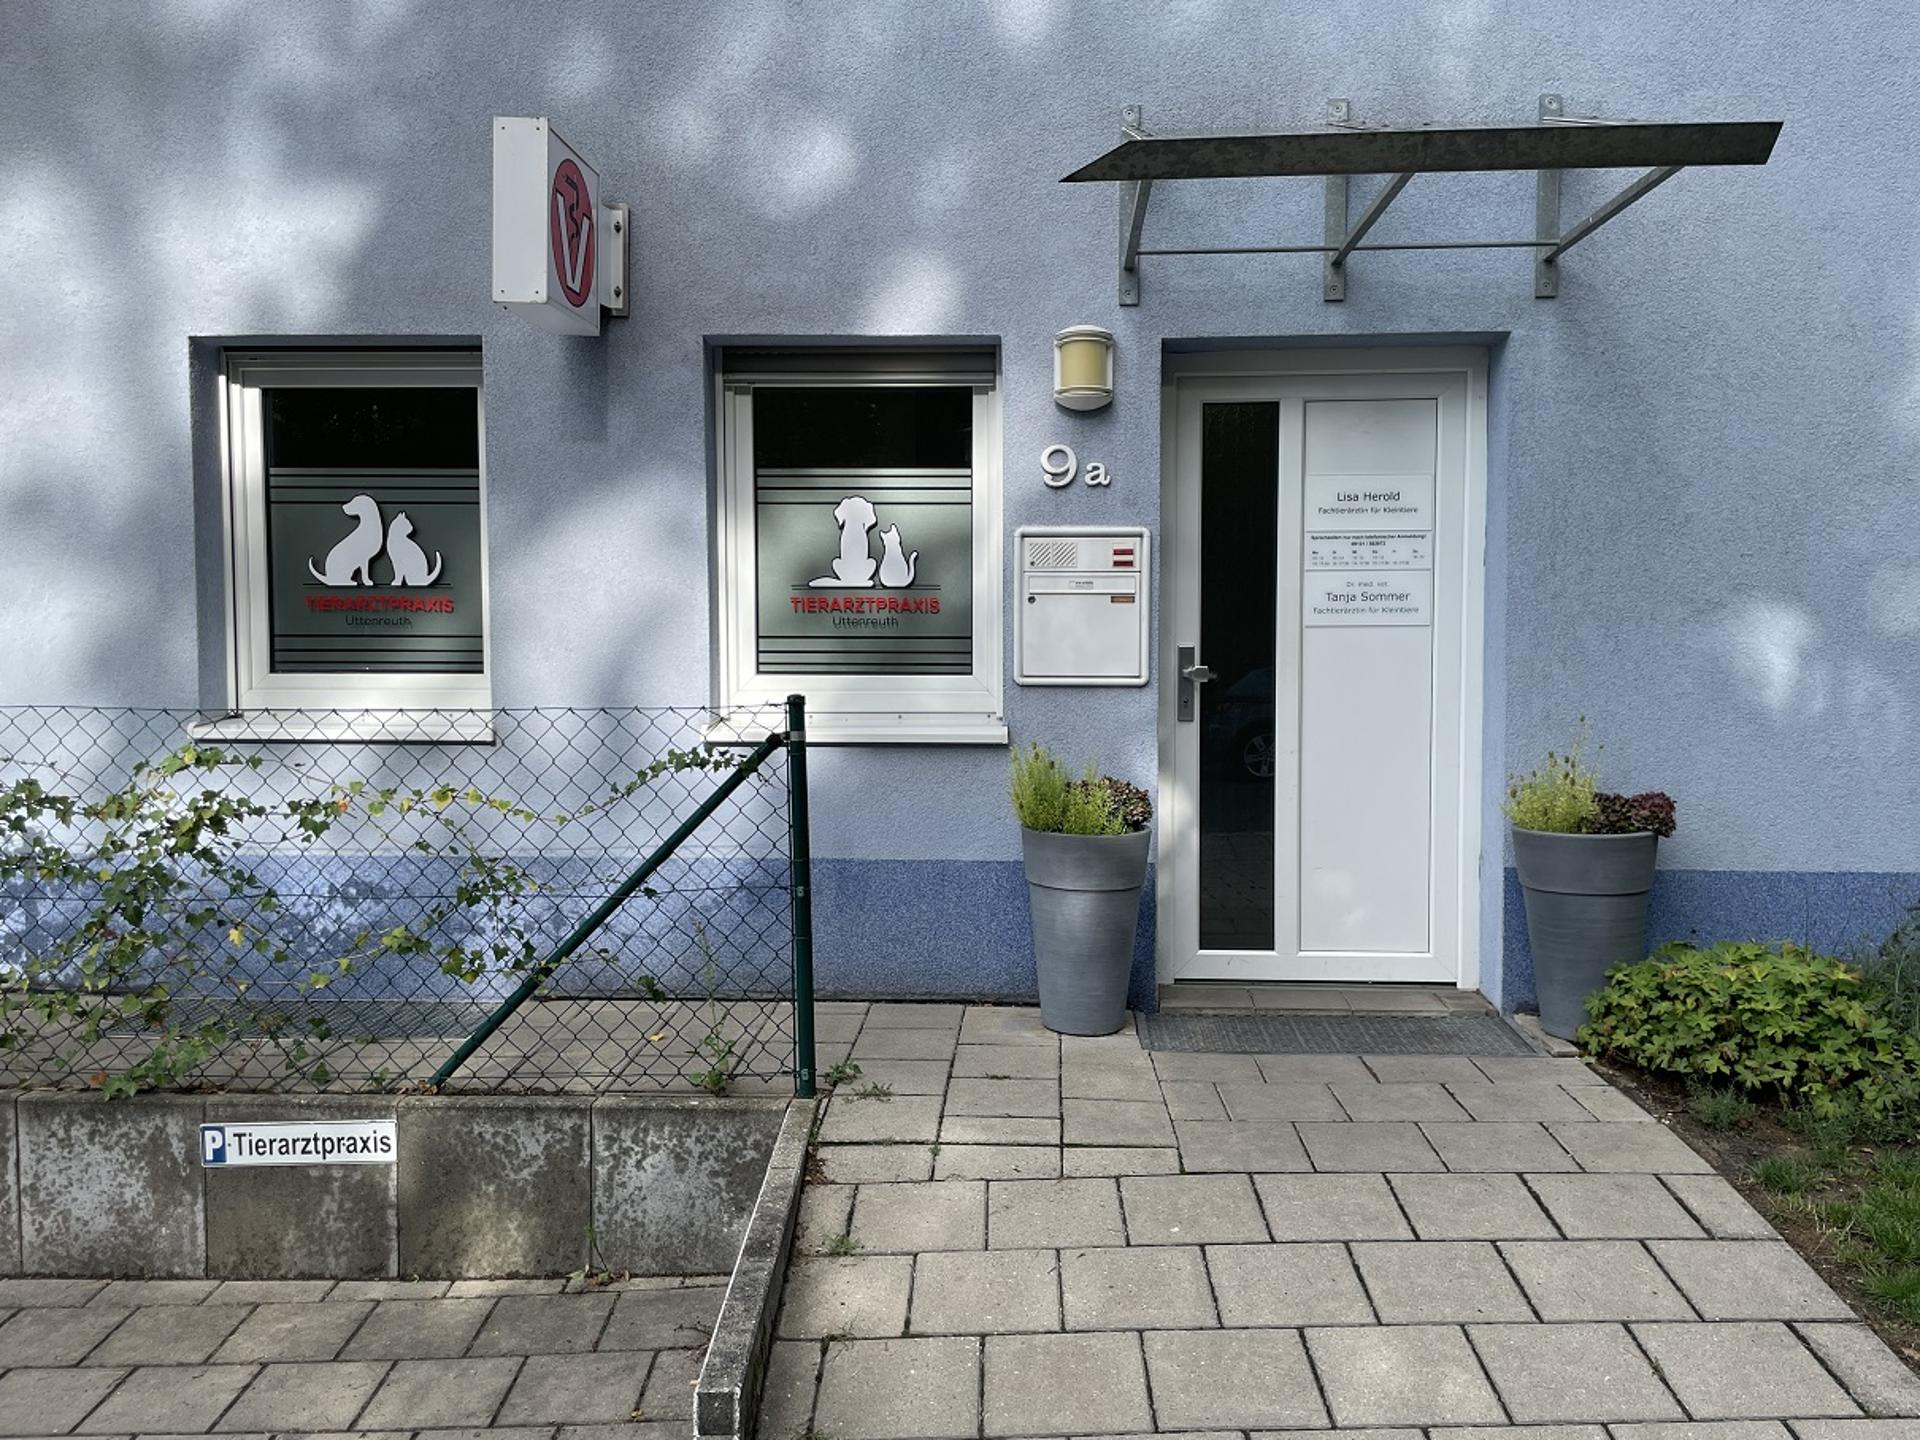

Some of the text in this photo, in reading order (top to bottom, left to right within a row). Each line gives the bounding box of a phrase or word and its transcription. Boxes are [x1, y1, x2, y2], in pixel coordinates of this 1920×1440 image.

[1040, 444, 1112, 488] 9a
[1336, 490, 1401, 502] Lisa Herold
[1318, 506, 1419, 515] Fachtierärztin für Kleintiere
[1326, 591, 1411, 604] Tanja Sommer
[305, 595, 455, 613] TIERARZTPRAXIS
[790, 596, 941, 614] TIERARZTPRAXIS
[1313, 606, 1420, 615] Fachtierärztin für Kleintiere
[345, 615, 412, 627] Uttenreuth
[832, 616, 900, 628] Uttenreuth
[233, 1130, 392, 1160] Tierarztpraxis
